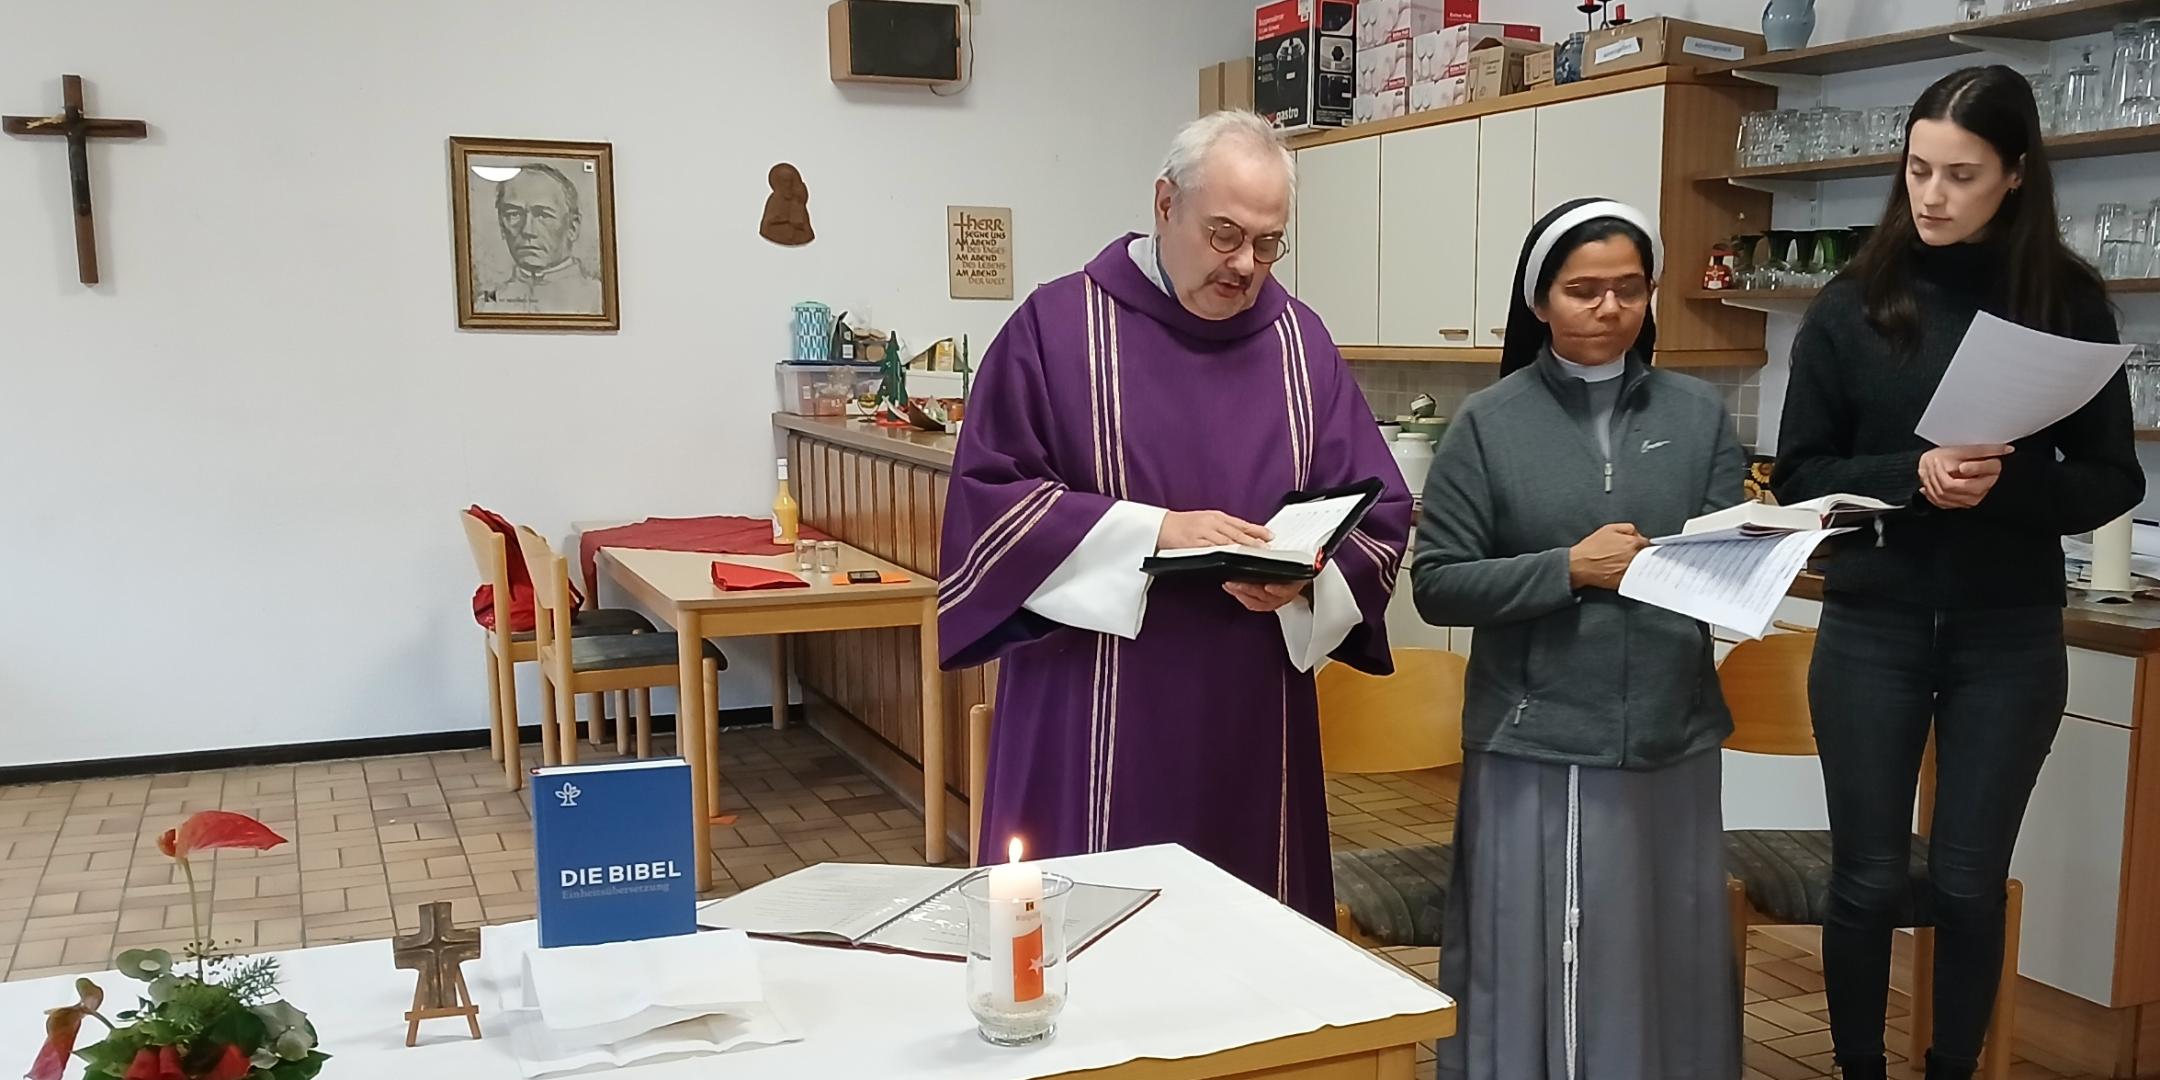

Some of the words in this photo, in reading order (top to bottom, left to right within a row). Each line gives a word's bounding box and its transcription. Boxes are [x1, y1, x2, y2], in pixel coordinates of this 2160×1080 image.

[1276, 106, 1299, 121] gastro
[970, 239, 997, 247] ABEND
[955, 253, 969, 261] AM
[955, 269, 969, 277] AM
[970, 269, 998, 277] ABEND
[560, 867, 603, 887] DIE
[608, 861, 682, 883] BIBEL
[561, 882, 670, 900] Einheitsübersetzung
